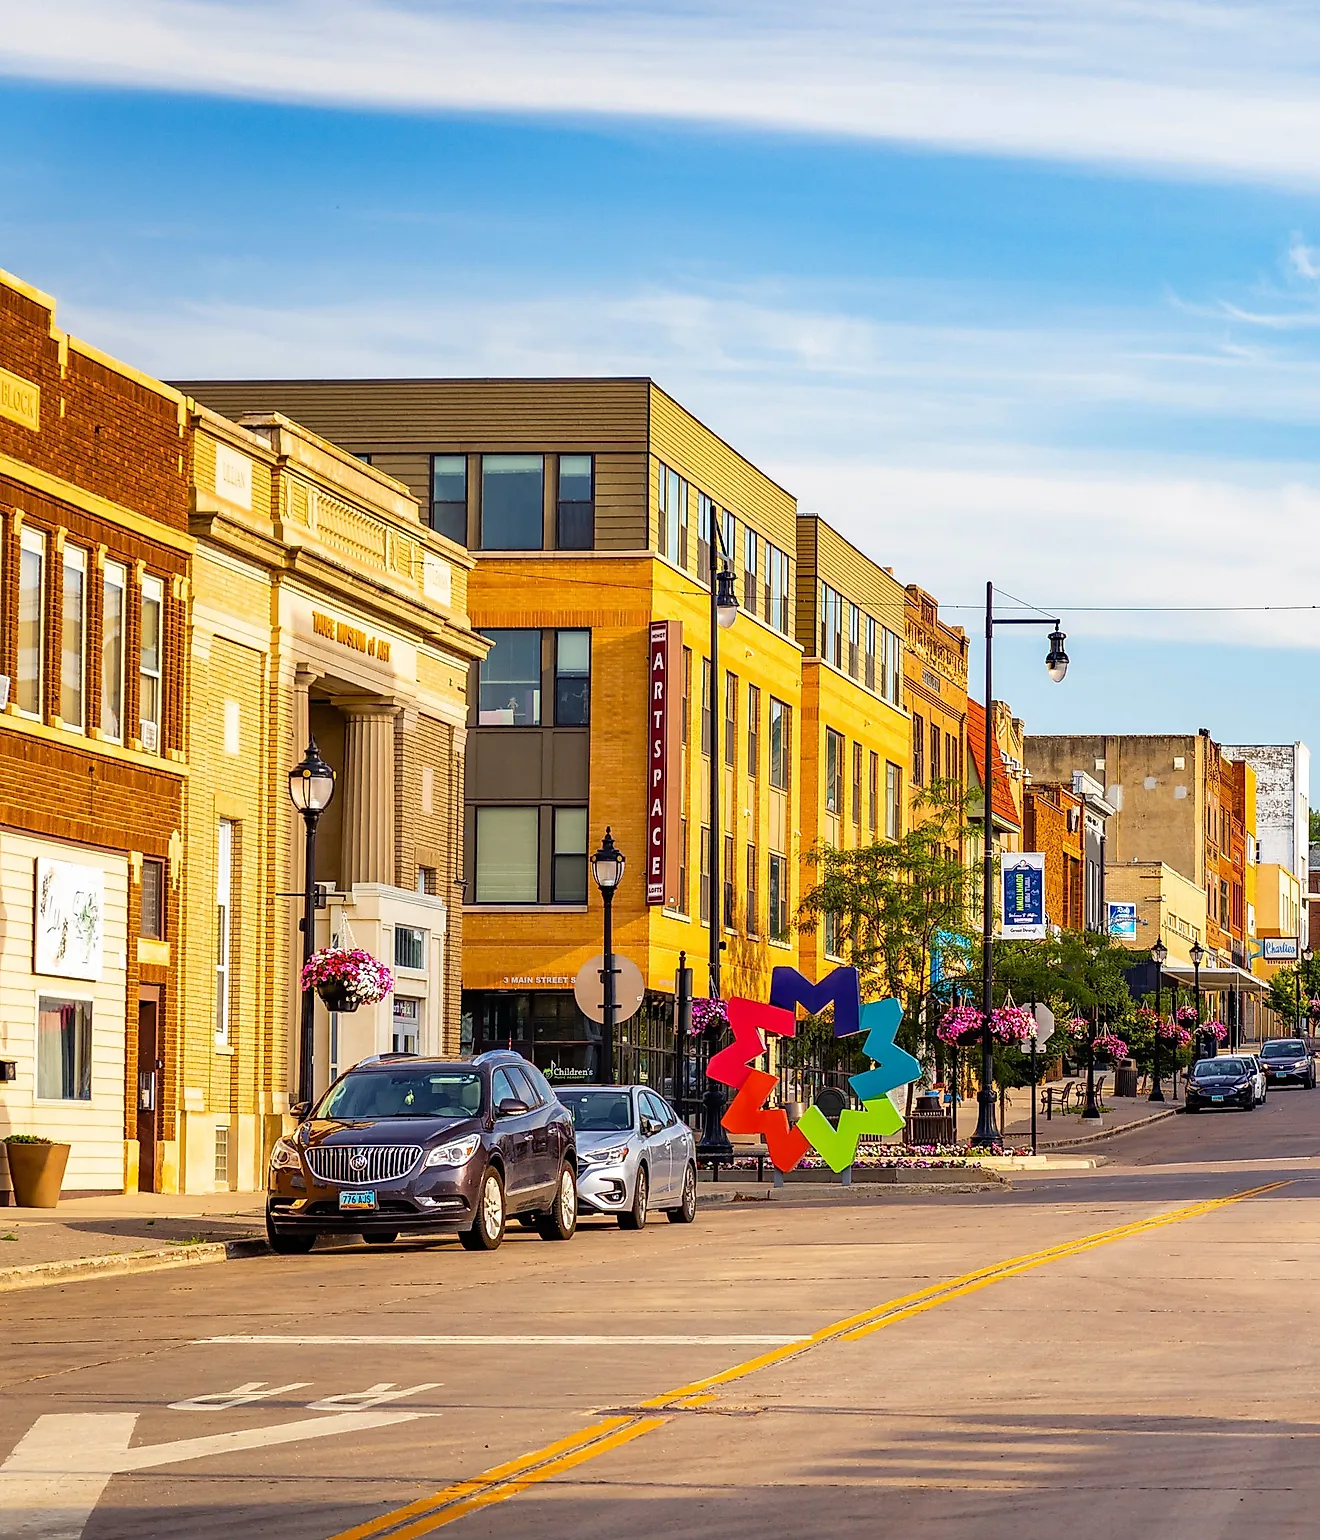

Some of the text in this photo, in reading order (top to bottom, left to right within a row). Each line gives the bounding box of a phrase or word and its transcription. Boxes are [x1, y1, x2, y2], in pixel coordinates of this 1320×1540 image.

[312, 610, 391, 662] TAUBE MUSEUM of ART
[650, 652, 664, 875] ARTSPACE
[1016, 874, 1024, 911] DOWNTOWN
[503, 976, 509, 984] 3
[511, 976, 533, 984] MAIN
[535, 976, 568, 984] STREET
[553, 1067, 594, 1076] Children's
[342, 1195, 357, 1204] 776
